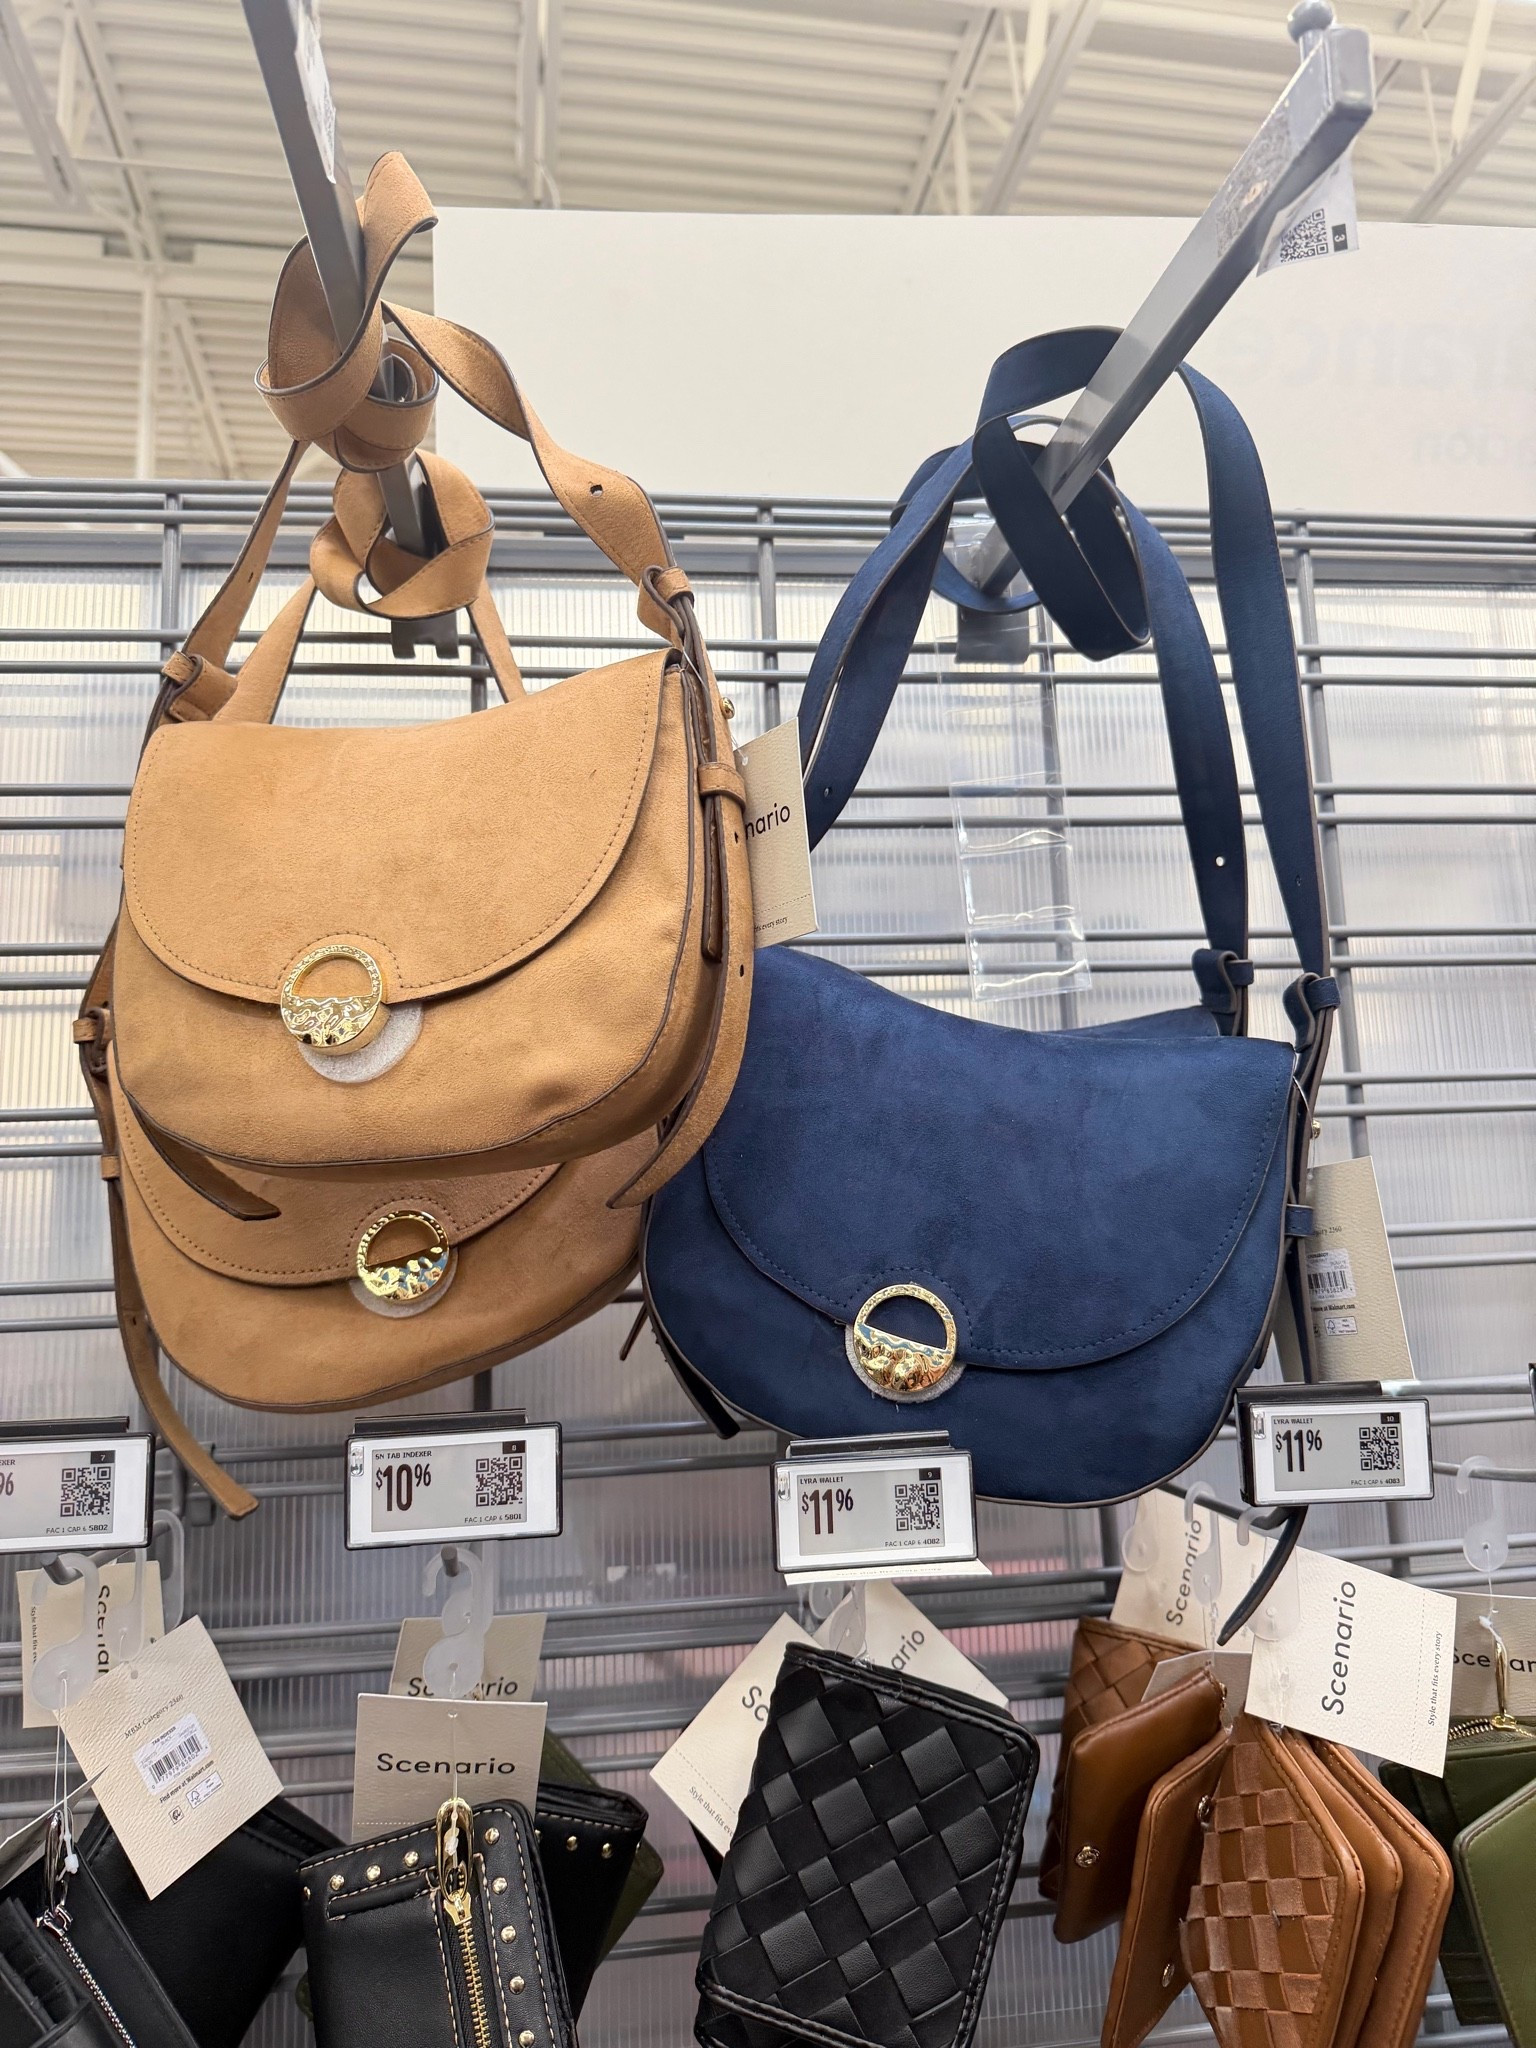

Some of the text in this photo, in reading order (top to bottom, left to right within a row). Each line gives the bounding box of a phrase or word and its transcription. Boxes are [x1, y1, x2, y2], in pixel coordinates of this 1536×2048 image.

[1335, 233, 1346, 243] 3
[100, 1454, 106, 1462] 7
[402, 1450, 432, 1458] INDEXER
[800, 1477, 818, 1485] LYRA
[1166, 1520, 1202, 1626] Scenario
[1321, 1580, 1357, 1716] Scenario
[1433, 1652, 1442, 1673] every
[1431, 1674, 1439, 1687] fits
[1430, 1688, 1438, 1704] that
[1428, 1704, 1437, 1726] Style
[376, 1752, 516, 1775] Scenario
[689, 1786, 704, 1804] Style
[703, 1801, 716, 1817] that
[714, 1814, 725, 1827] fits
